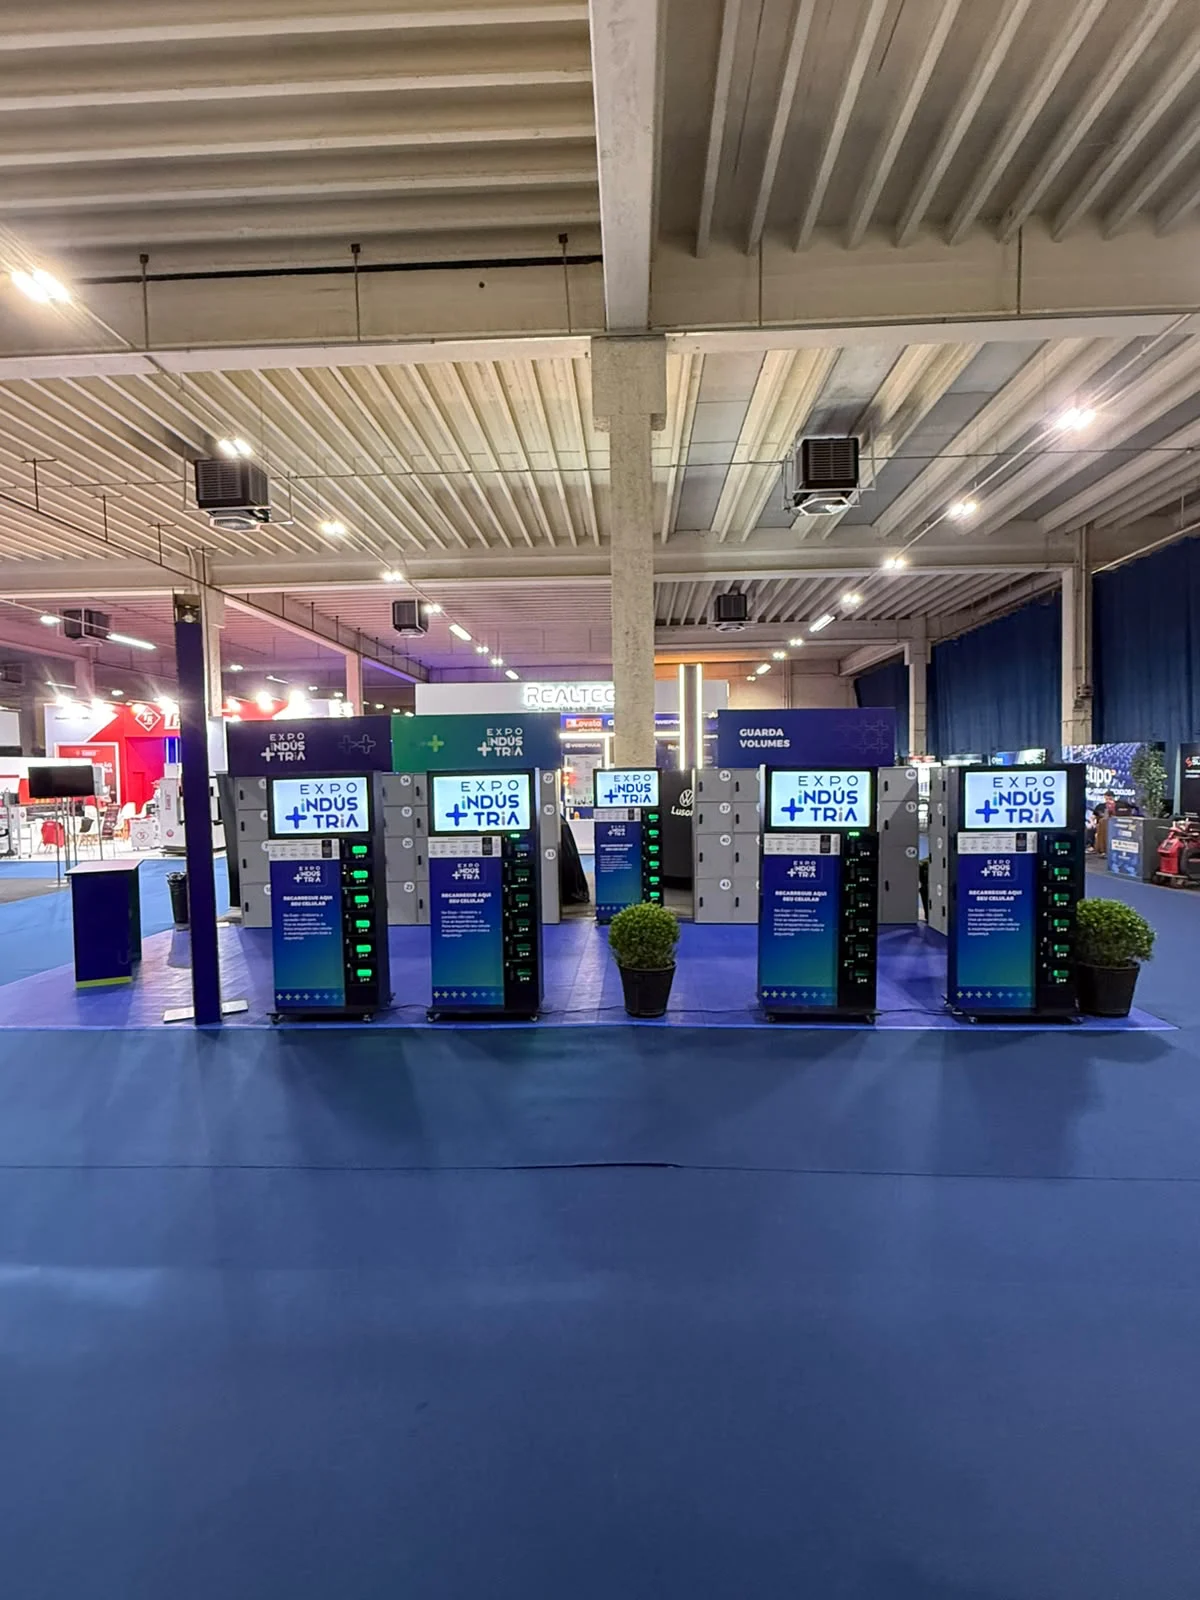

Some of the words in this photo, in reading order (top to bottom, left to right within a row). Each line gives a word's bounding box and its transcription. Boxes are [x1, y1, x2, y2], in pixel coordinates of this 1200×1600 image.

[486, 727, 523, 736] EXPO
[739, 728, 784, 737] GUARDA
[269, 732, 305, 742] EXPO
[739, 739, 790, 748] VOLUMES
[614, 774, 651, 782] EXPO
[798, 775, 858, 786] EXPO
[993, 776, 1055, 788] EXPO
[300, 782, 357, 794] EXPO
[461, 780, 519, 792] EXPO
